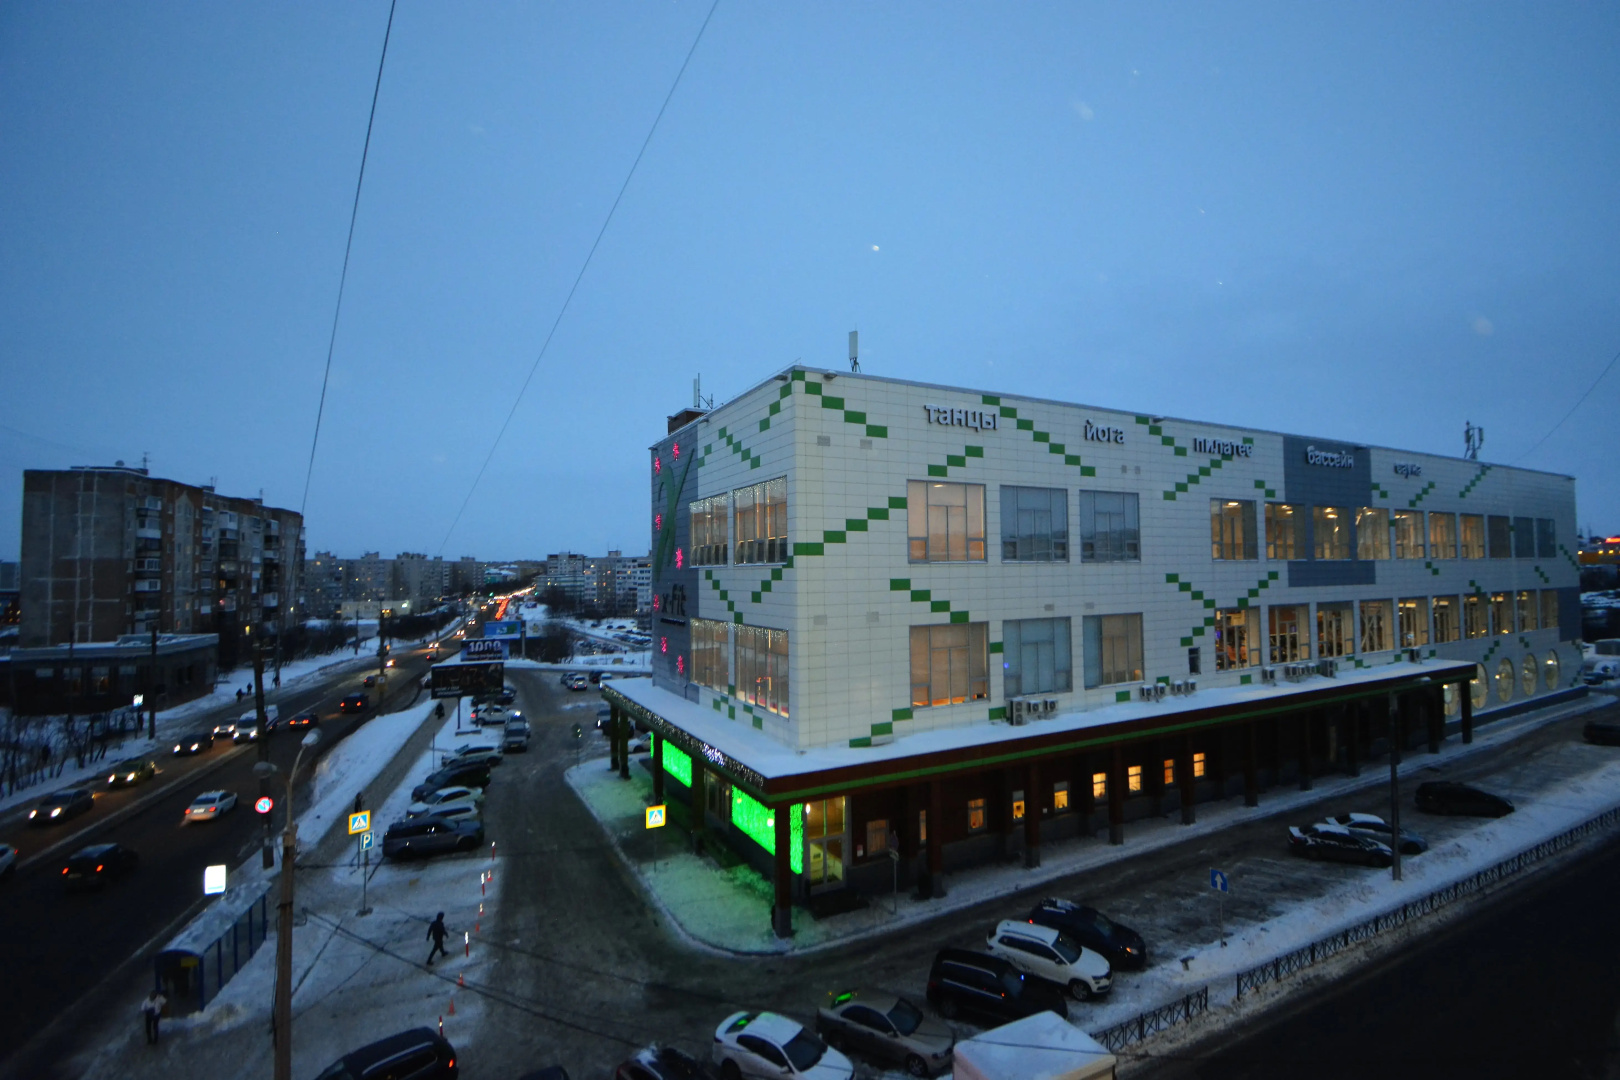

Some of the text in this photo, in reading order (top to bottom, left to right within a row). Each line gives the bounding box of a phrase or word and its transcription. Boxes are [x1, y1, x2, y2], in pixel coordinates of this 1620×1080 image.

[924, 404, 998, 432] танцы
[1084, 417, 1124, 444] йога
[1193, 437, 1252, 460] пилатес
[1305, 445, 1355, 469] бассейн
[363, 834, 371, 849] P
